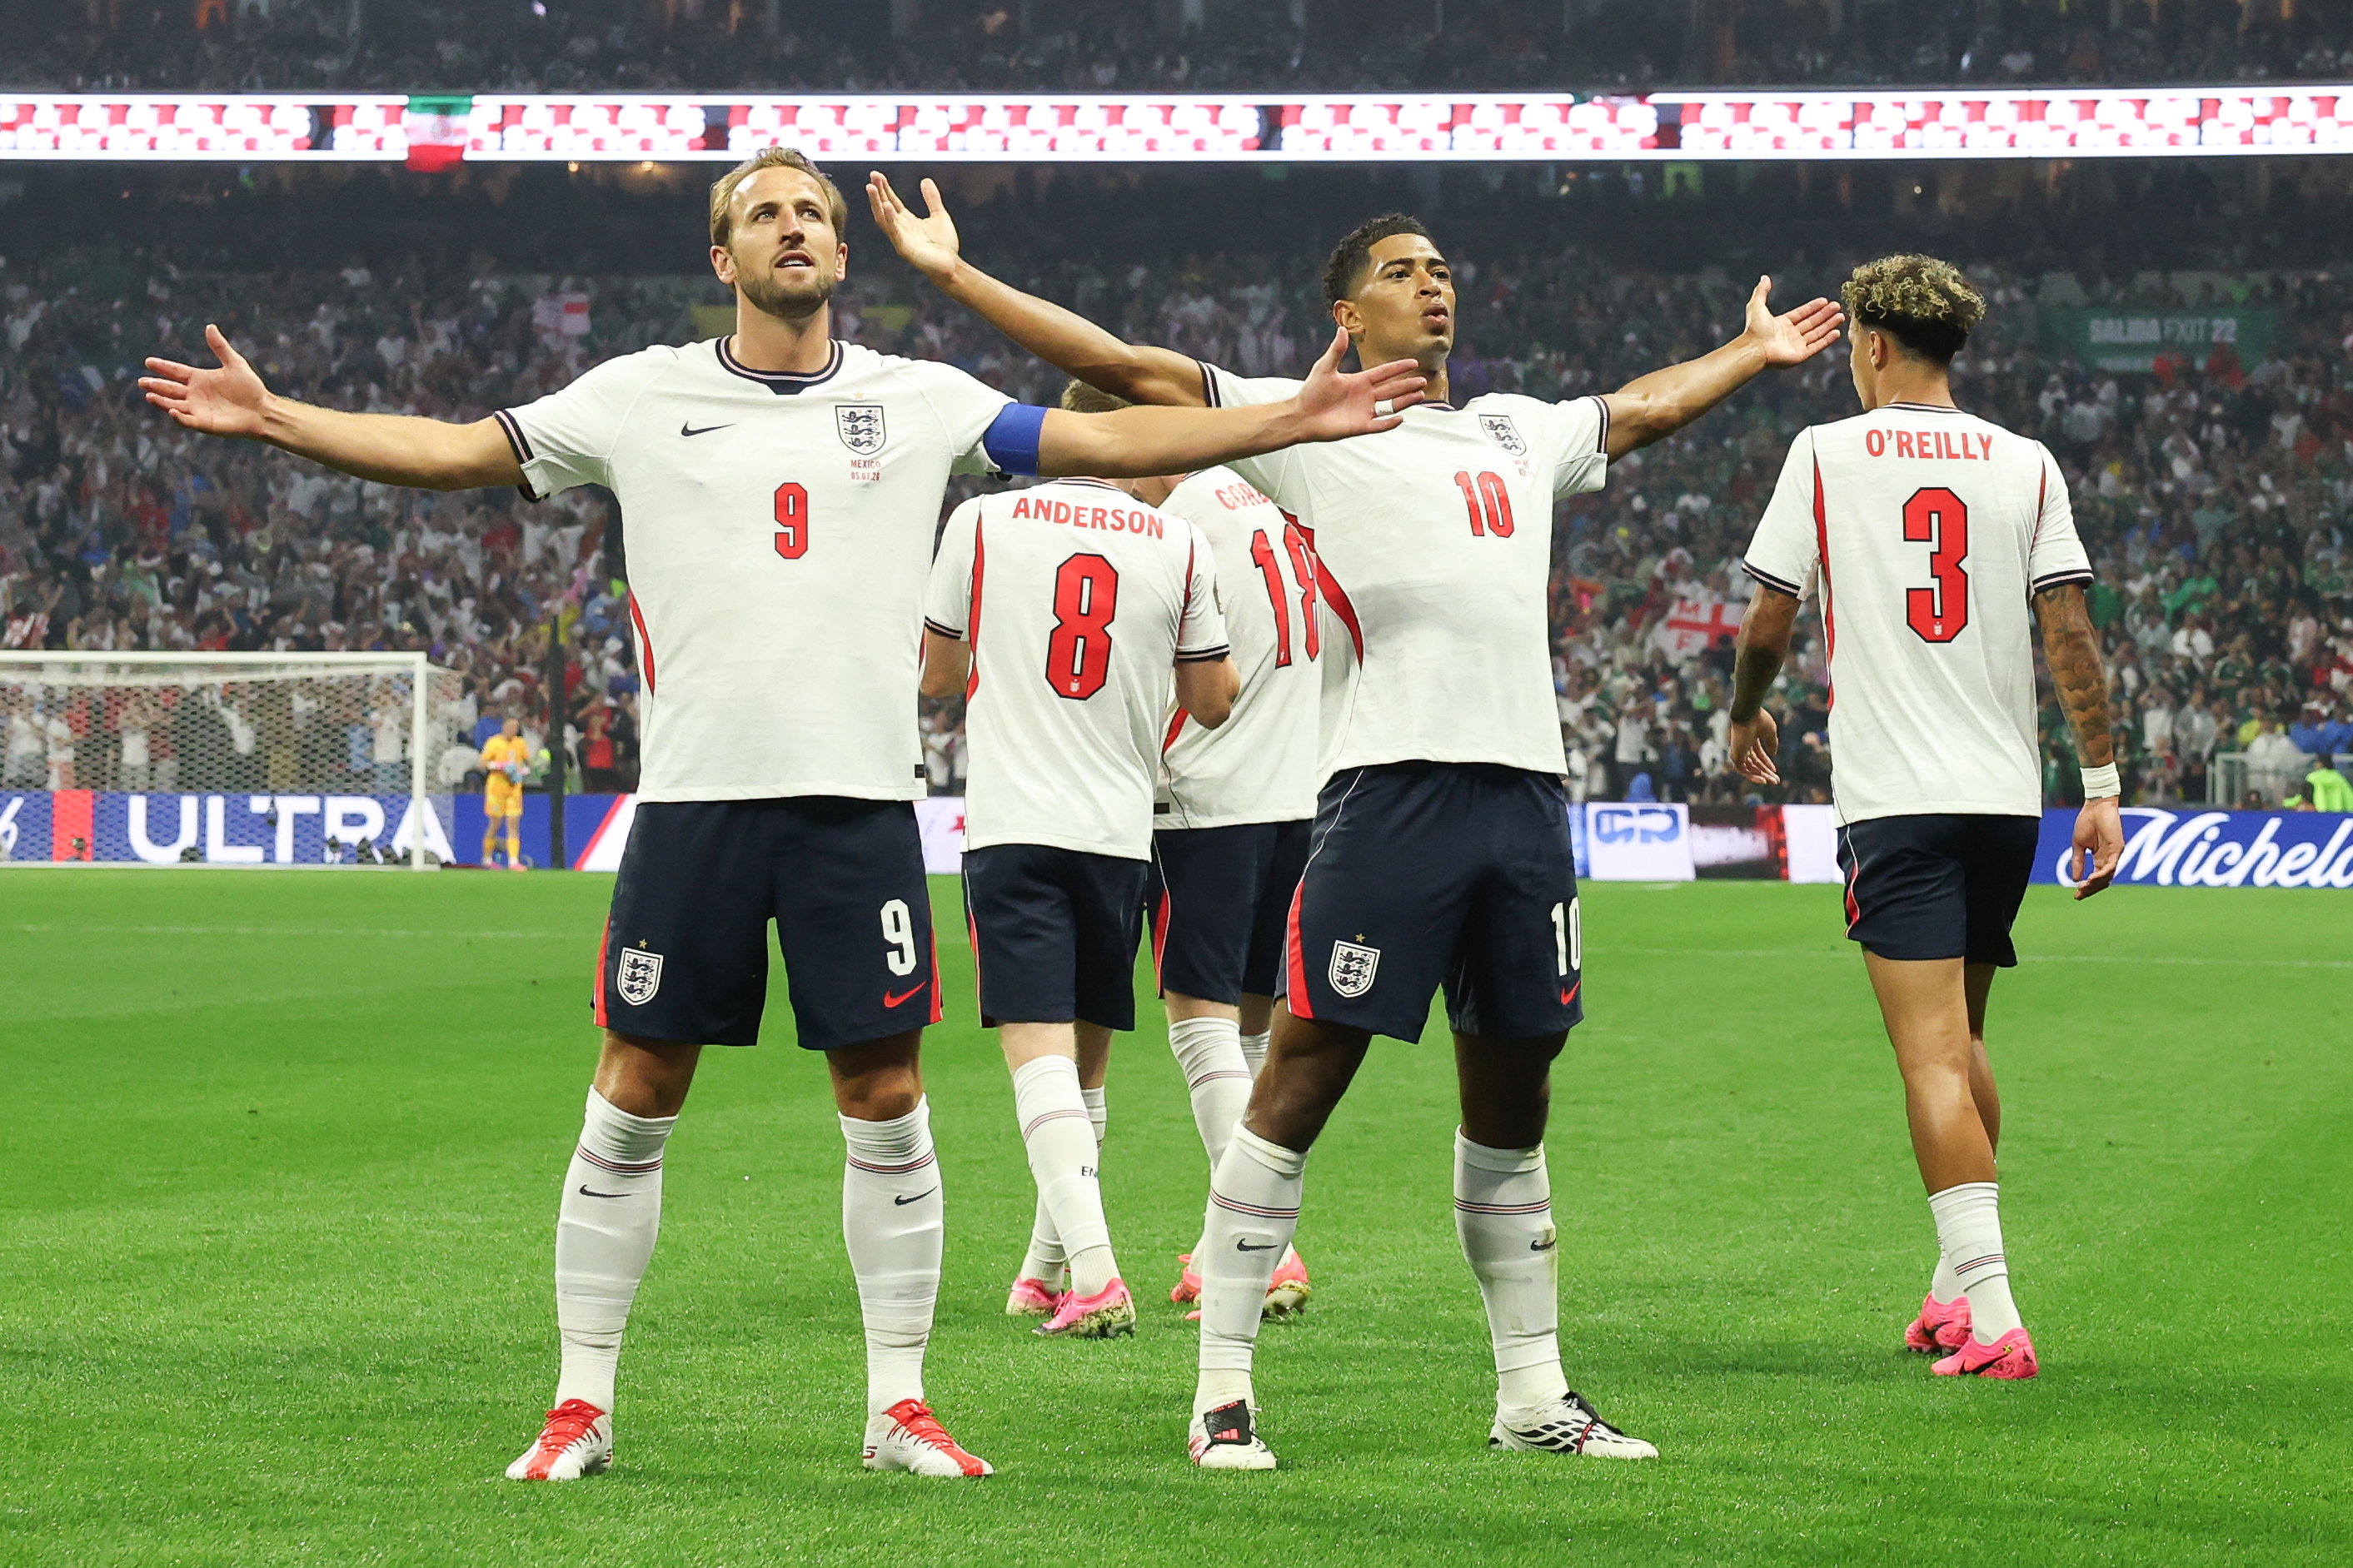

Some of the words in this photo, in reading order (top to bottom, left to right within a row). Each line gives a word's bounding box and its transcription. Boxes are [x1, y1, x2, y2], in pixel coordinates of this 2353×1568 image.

[2163, 318, 2206, 342] EXIT
[2211, 318, 2237, 343] 22
[850, 459, 880, 468] MEXICO
[1866, 429, 1992, 460] O'REILLY
[775, 482, 808, 560] 9
[1012, 497, 1163, 540] ANDERSON
[1454, 471, 1514, 538] 10
[1902, 487, 1968, 643] 3
[1044, 552, 1119, 701] 8
[127, 794, 456, 864] ULTRA
[880, 898, 916, 976] 9
[1551, 896, 1581, 976] 10
